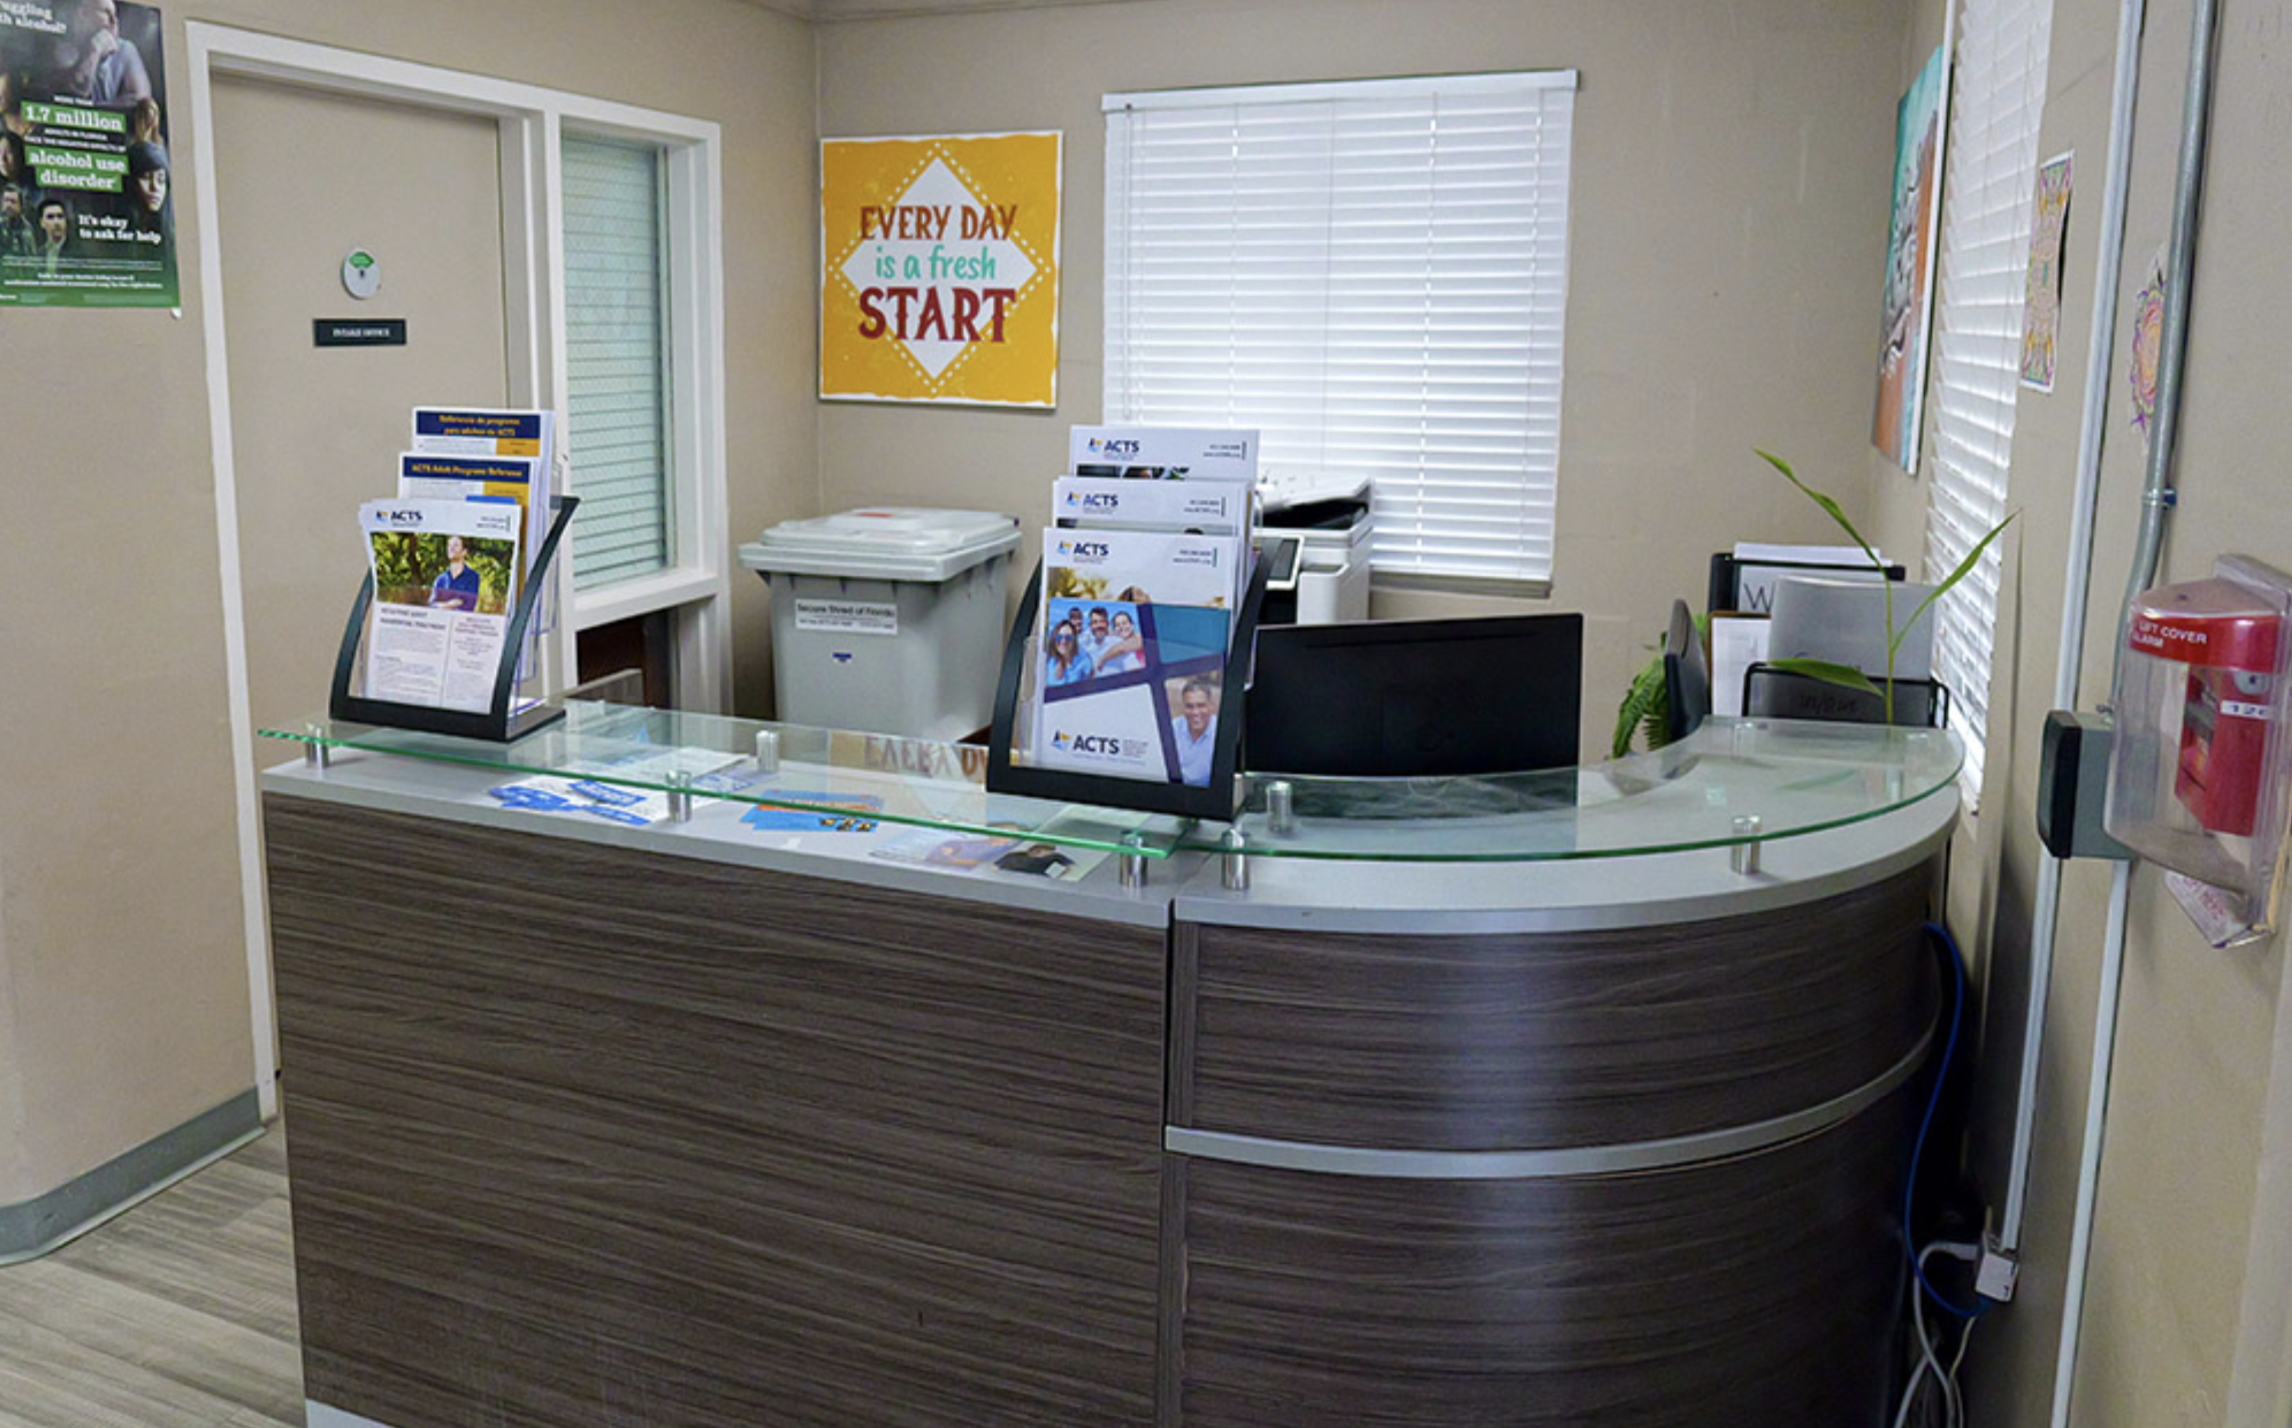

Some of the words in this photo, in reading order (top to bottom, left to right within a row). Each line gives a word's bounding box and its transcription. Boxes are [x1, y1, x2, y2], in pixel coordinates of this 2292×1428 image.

[26, 105, 50, 122] 1.7
[55, 108, 123, 131] million
[29, 149, 93, 170] alcohol
[96, 158, 126, 173] use
[40, 169, 116, 189] disorder
[78, 214, 98, 226] It's
[100, 216, 128, 230] okay
[860, 204, 952, 241] EVERY
[960, 204, 1017, 241] DAY
[80, 229, 92, 239] to
[94, 229, 115, 240] ask
[117, 230, 135, 240] for
[136, 230, 162, 245] help
[875, 245, 897, 280] is
[903, 257, 921, 280] a
[929, 244, 996, 281] fresh
[858, 284, 1018, 343] START
[1103, 440, 1140, 453] ACTS
[1083, 494, 1119, 508] ACTS
[390, 510, 423, 521] ACTS
[1073, 543, 1109, 556] ACTS
[2160, 626, 2208, 645] COVER
[1073, 734, 1120, 754] ACTS
